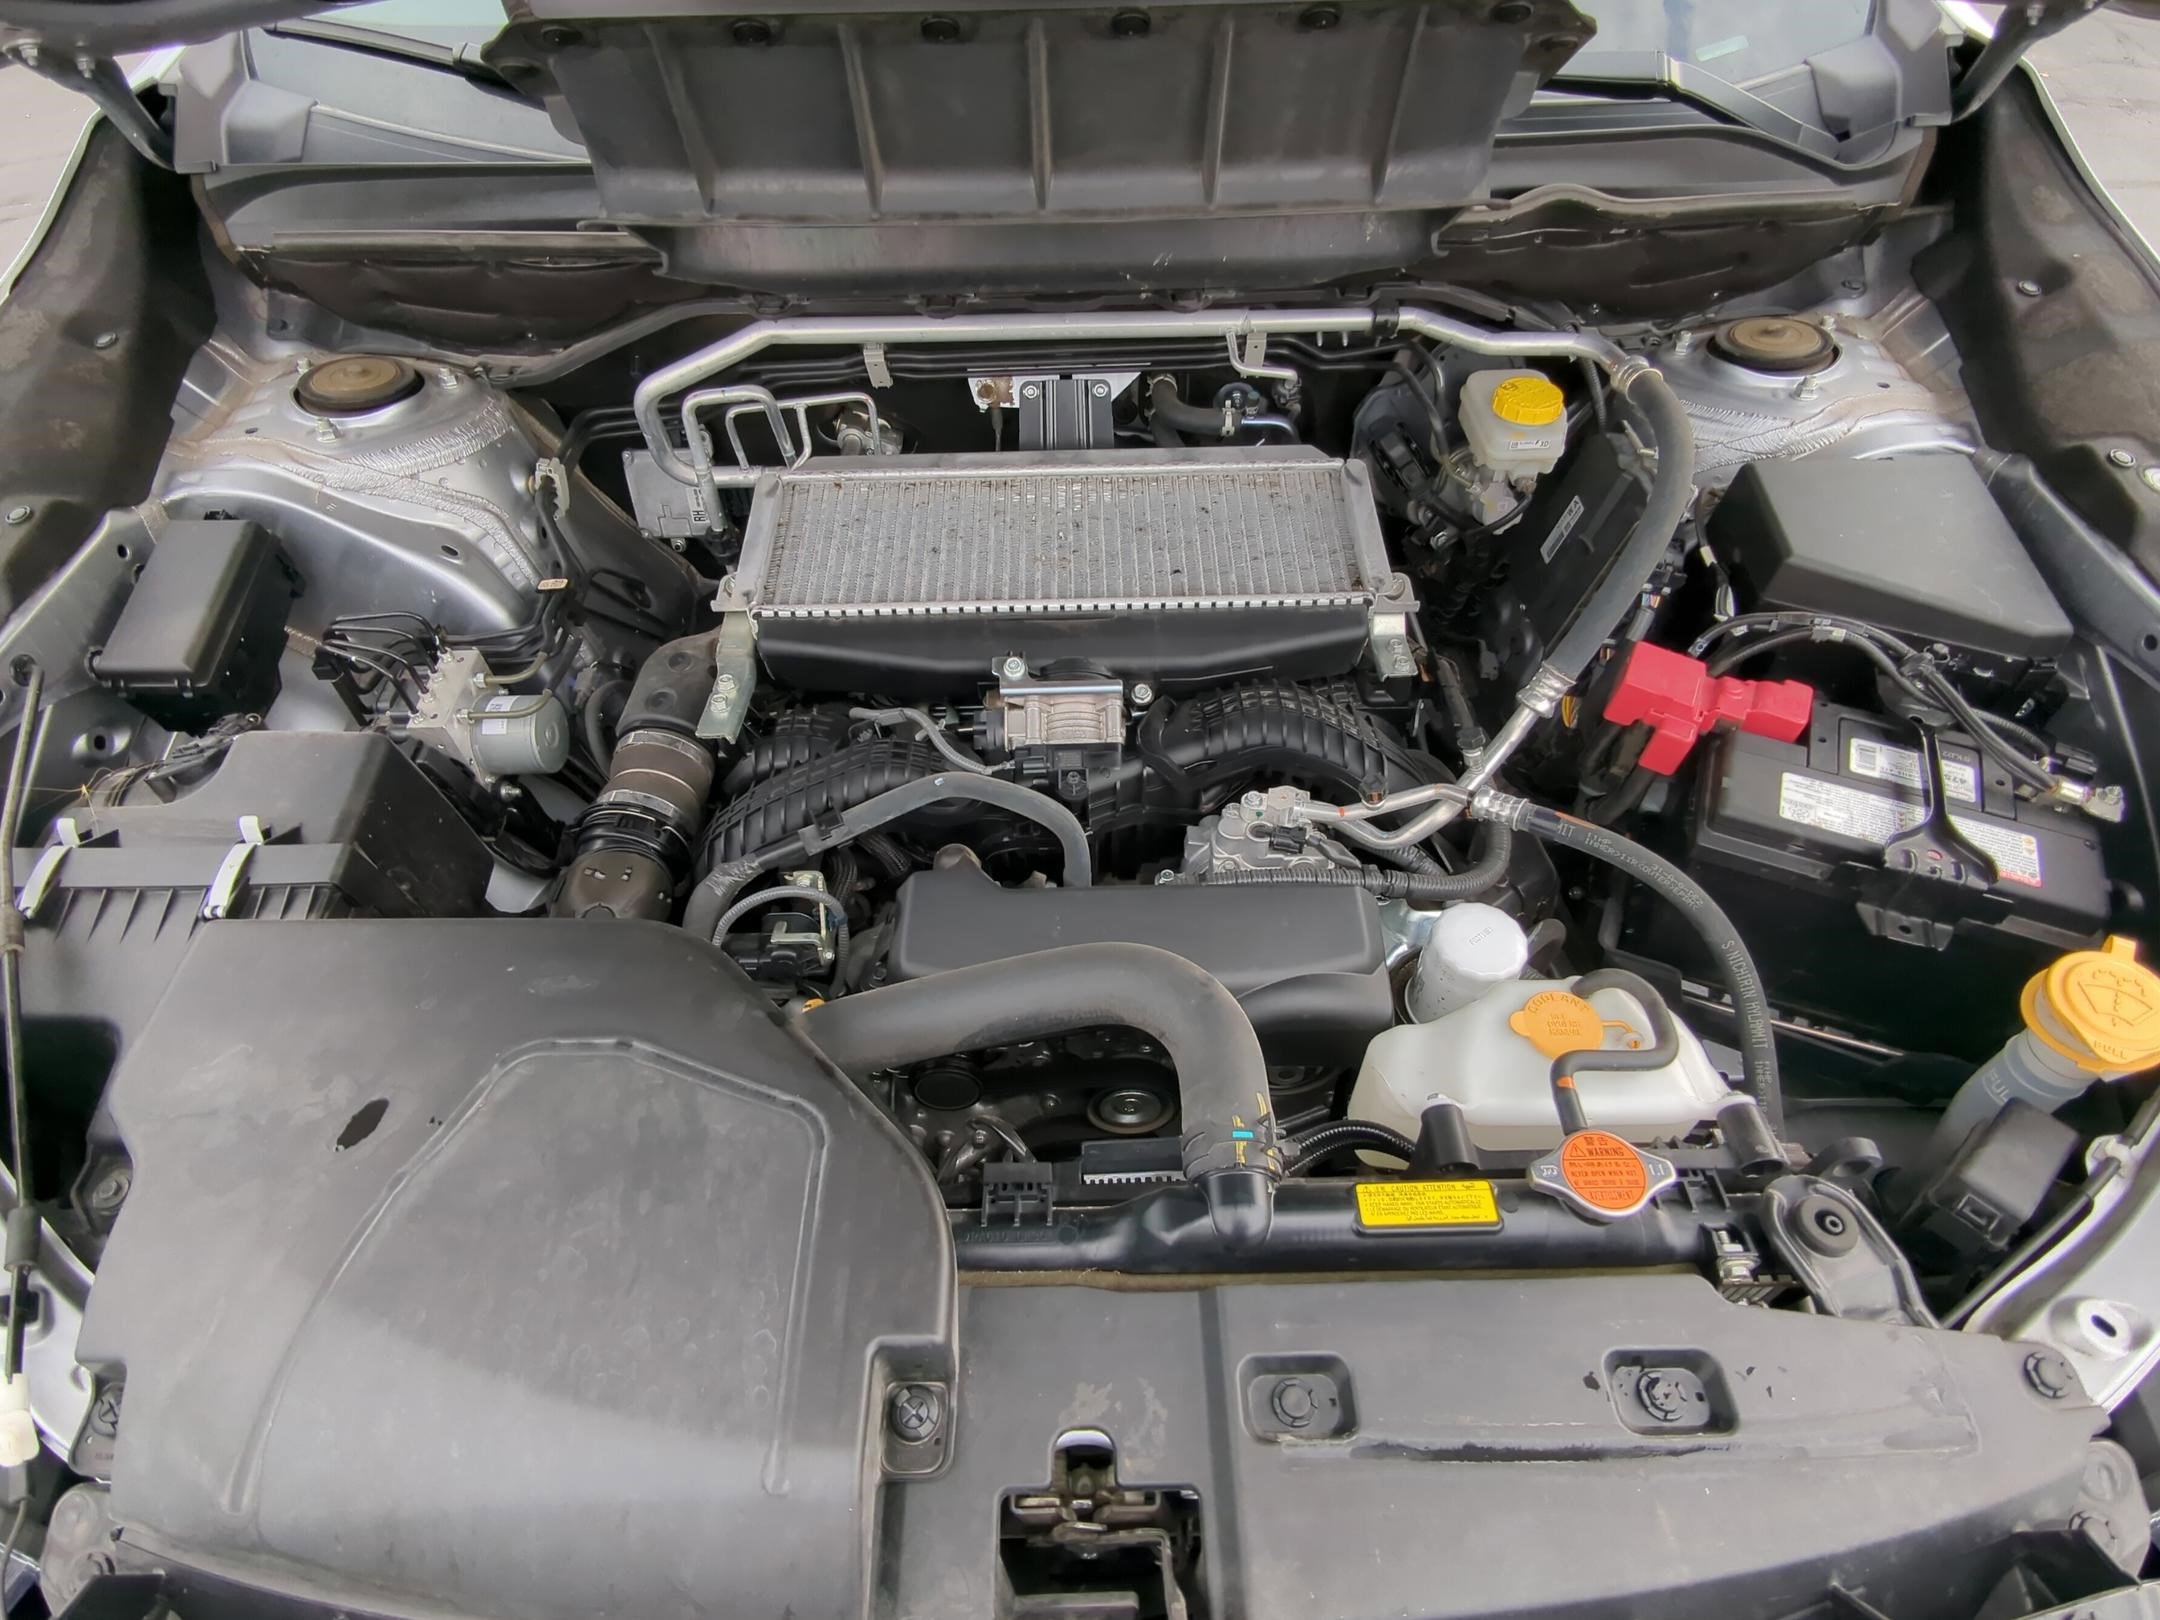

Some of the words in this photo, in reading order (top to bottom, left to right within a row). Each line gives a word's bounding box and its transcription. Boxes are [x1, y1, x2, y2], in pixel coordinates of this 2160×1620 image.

[692, 510, 706, 522] RH
[1527, 993, 1591, 1015] COOLANT
[1587, 1146, 1625, 1157] WARNING
